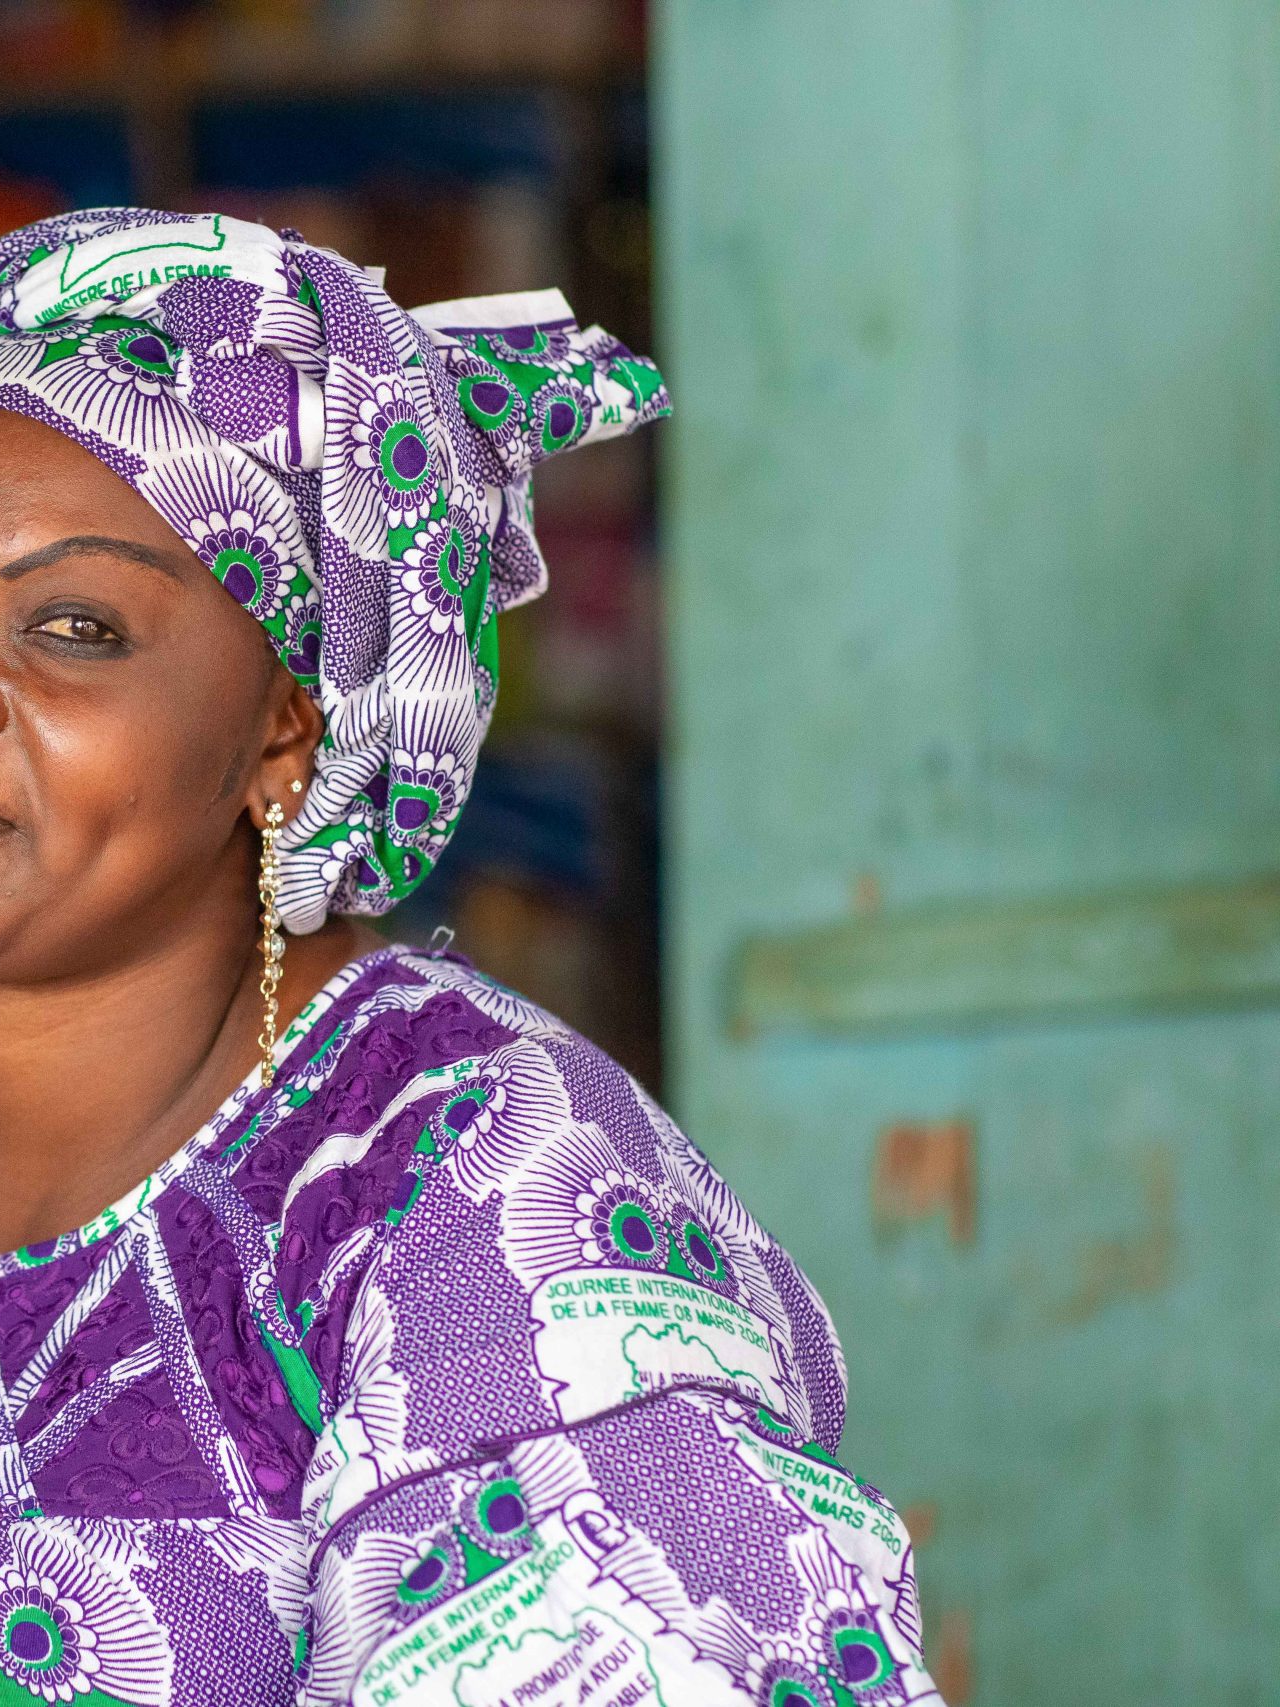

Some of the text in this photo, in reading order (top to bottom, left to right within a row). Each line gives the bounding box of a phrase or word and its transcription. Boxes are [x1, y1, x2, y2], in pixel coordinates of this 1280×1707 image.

[111, 273, 134, 295] DE
[164, 264, 233, 283] FEMME
[545, 1277, 754, 1327] JOURNEE INTERNATIONALE
[551, 1300, 771, 1354] DE LA FEMME 08 MARS 2020
[762, 1448, 896, 1527] INTERNATIONALE
[810, 1494, 866, 1530] MARS
[870, 1518, 902, 1557] 2020
[363, 1621, 443, 1688] JOURNEE
[372, 1681, 402, 1707] DE
[401, 1664, 429, 1688] LA
[426, 1621, 492, 1670] FEMME
[491, 1604, 518, 1629] 08
[578, 1620, 604, 1647] DE
[589, 1637, 637, 1688] ATOUT
